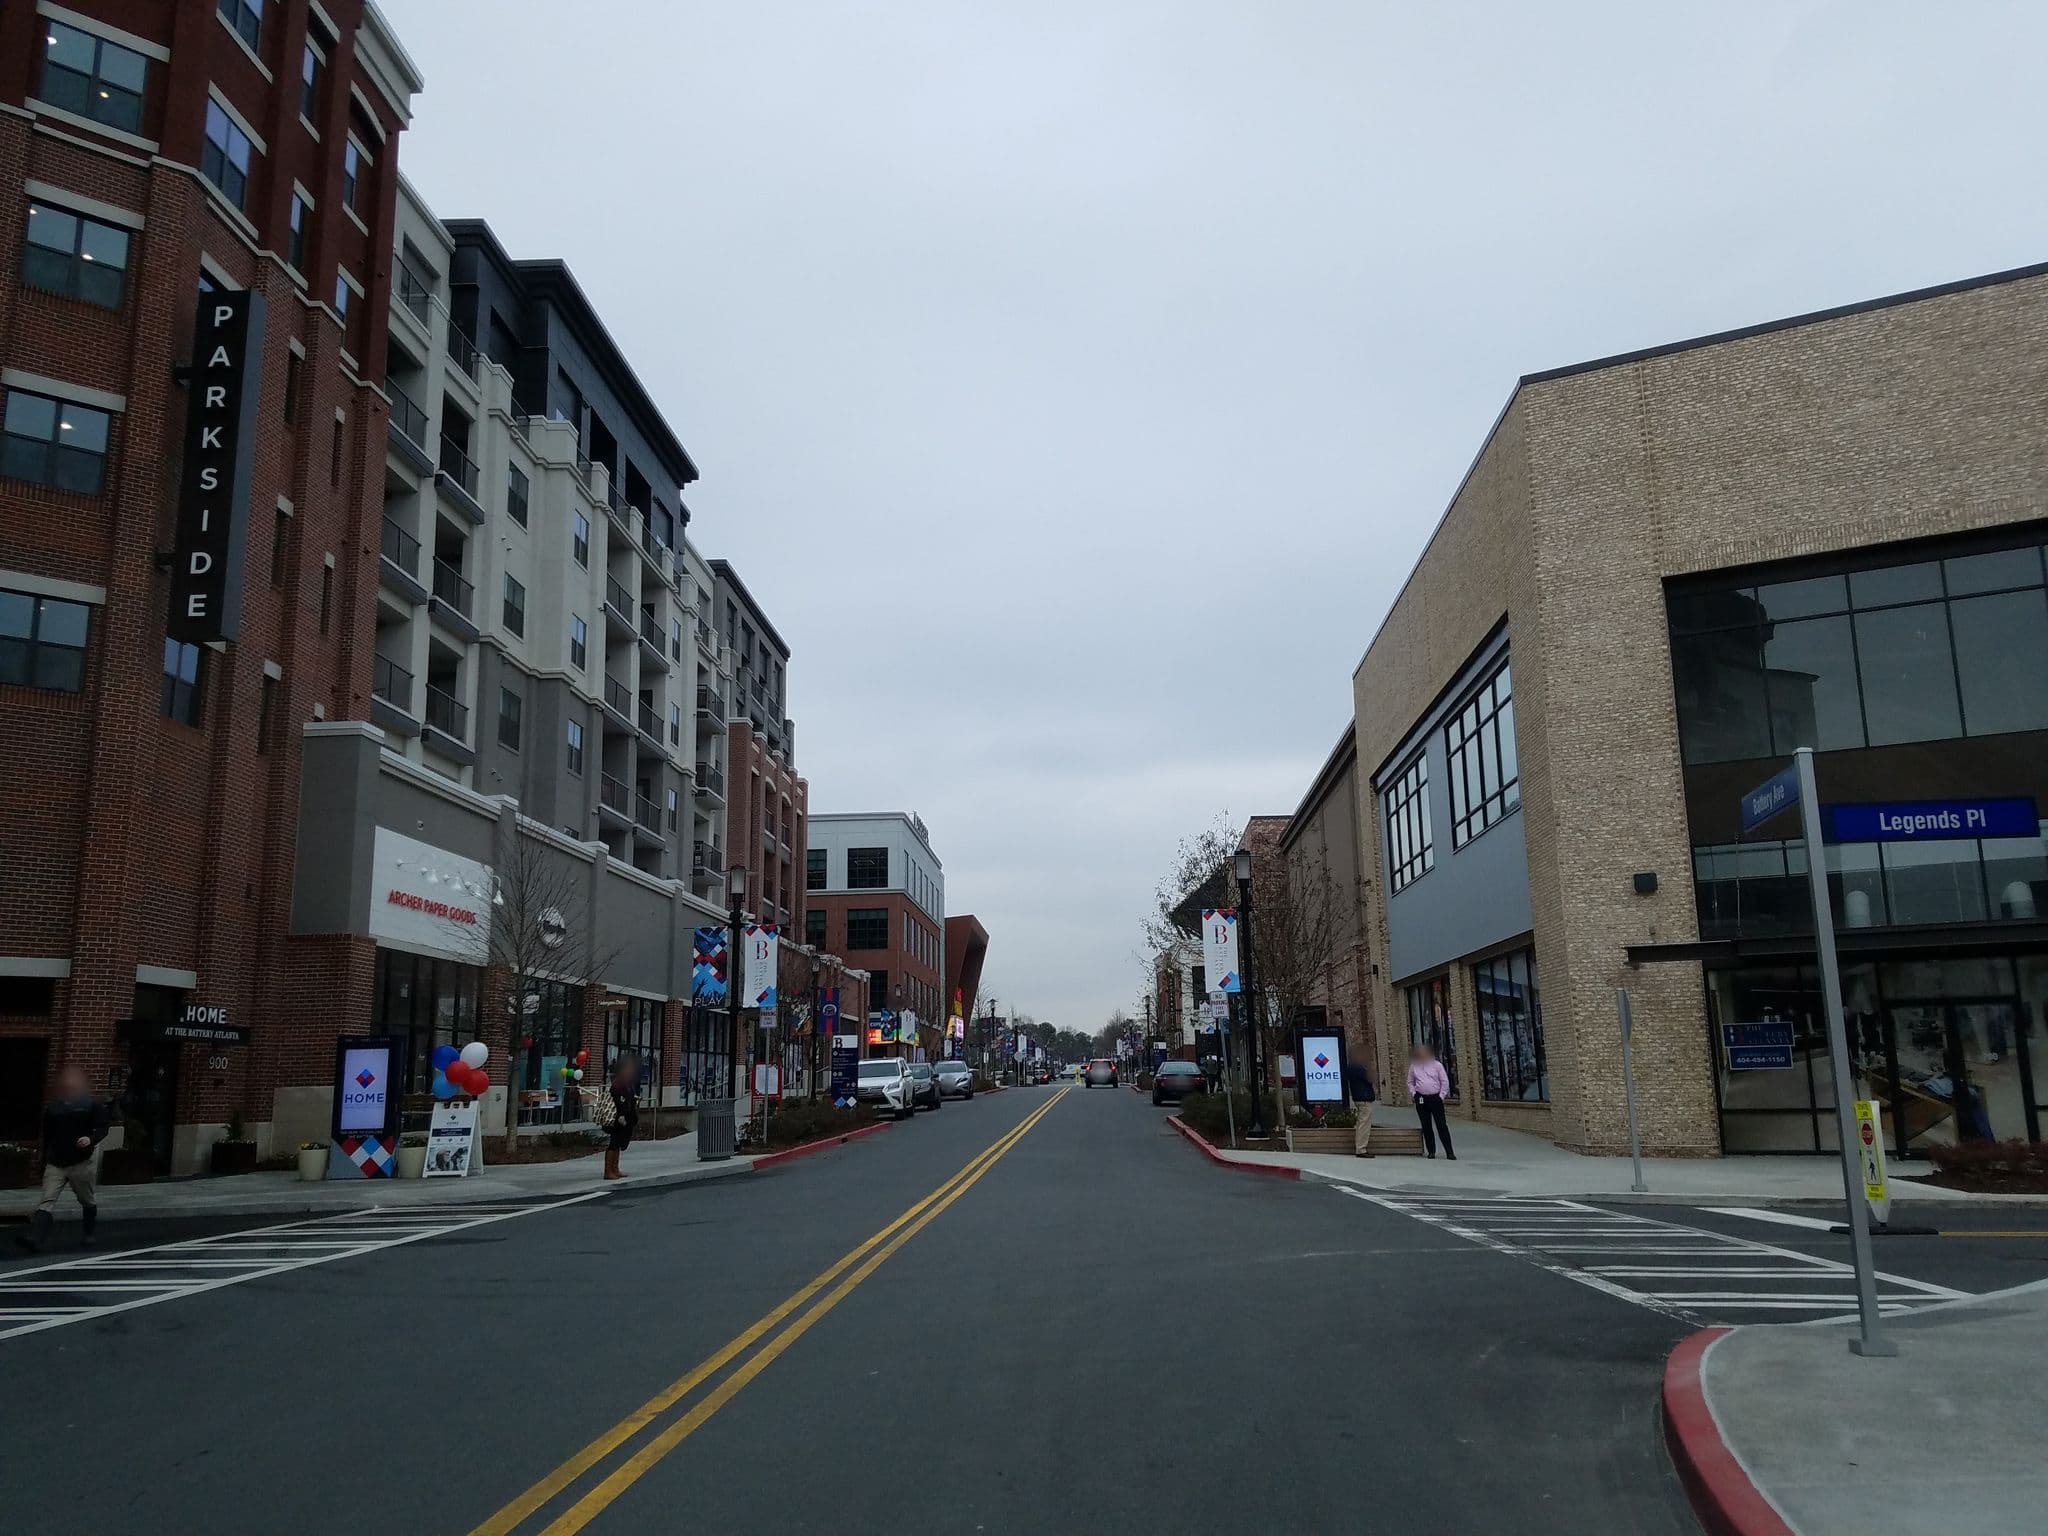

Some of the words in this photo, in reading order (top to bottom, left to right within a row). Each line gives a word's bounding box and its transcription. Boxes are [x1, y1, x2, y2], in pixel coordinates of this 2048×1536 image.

[187, 305, 234, 617] PARKSIDE
[1880, 810, 1960, 834] Legends
[1966, 809, 1986, 828] Pl
[388, 889, 423, 910] ARCHER
[424, 899, 448, 917] PAPER
[449, 907, 476, 924] GOODS
[1213, 924, 1228, 945] B
[754, 940, 769, 960] B
[694, 996, 723, 1007] PLAY
[165, 1026, 174, 1036] AT
[175, 1027, 187, 1037] THE
[188, 1028, 214, 1039] BATTERY
[214, 1031, 240, 1041] ATLANTA
[208, 1055, 228, 1070] 900
[1307, 1071, 1339, 1080] HOME
[344, 1093, 384, 1104] HOME
